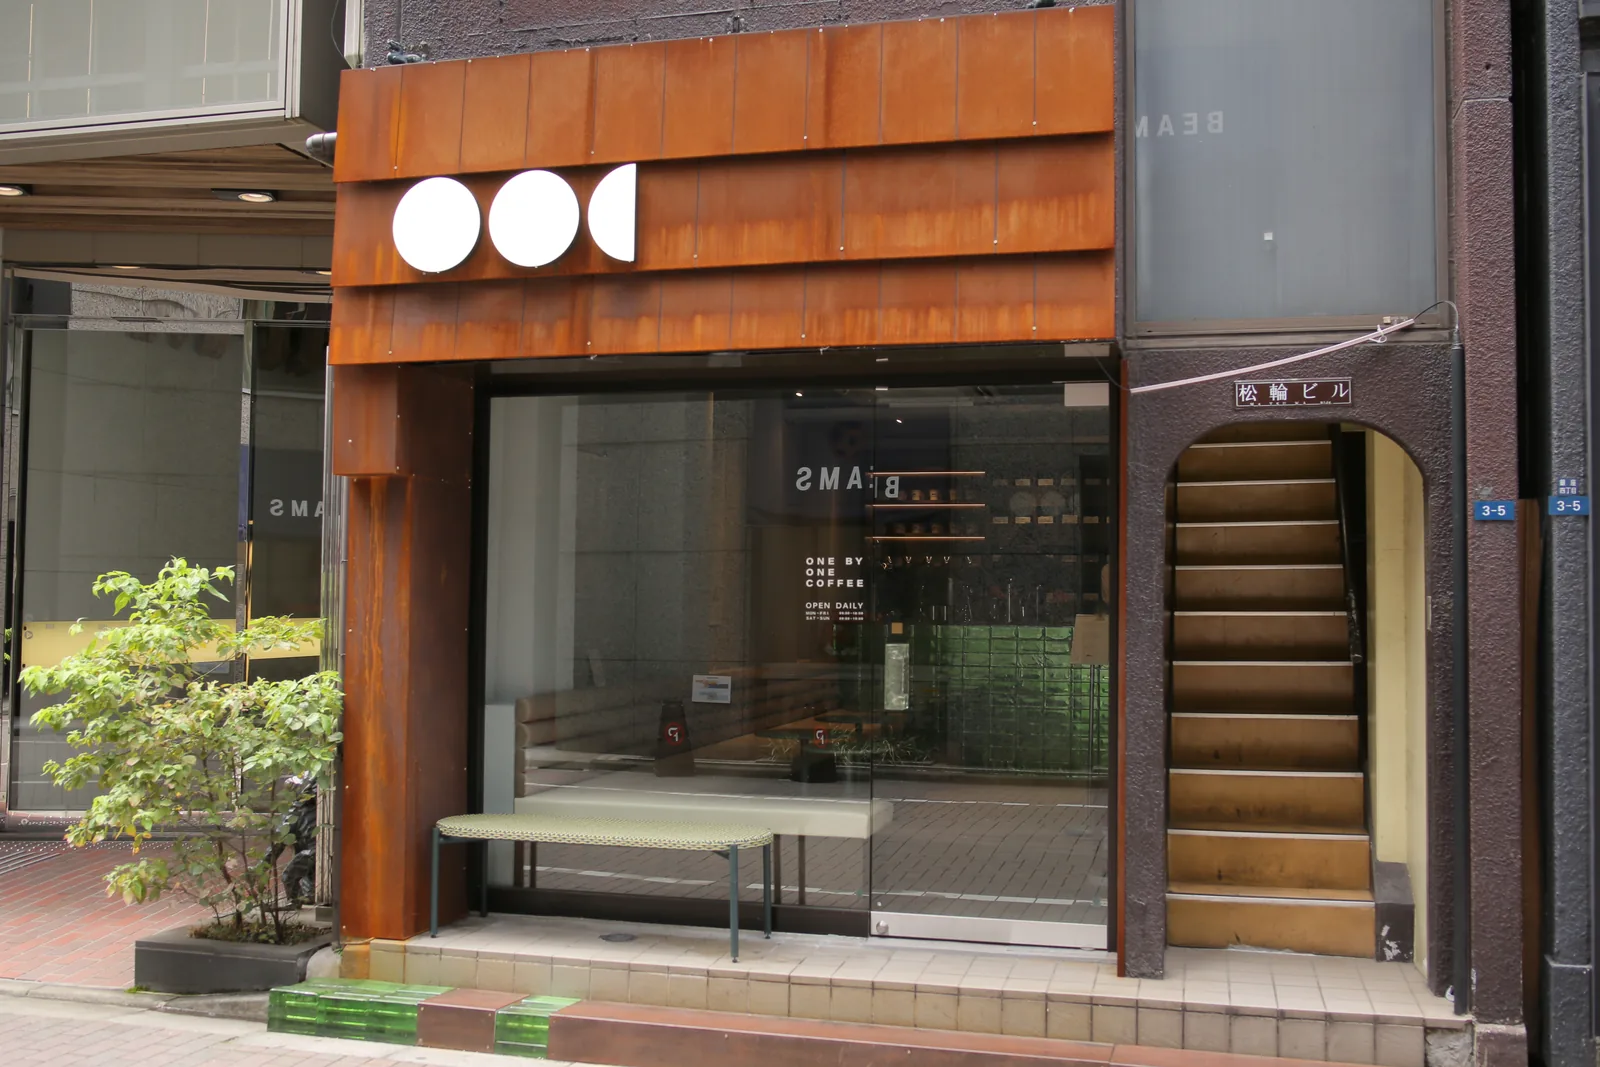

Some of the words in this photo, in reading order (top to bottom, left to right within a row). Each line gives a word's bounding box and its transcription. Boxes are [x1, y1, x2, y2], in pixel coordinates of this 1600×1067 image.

[1238, 383, 1349, 402] 松輪ビル
[1481, 505, 1506, 516] 3-5
[1556, 500, 1581, 511] 3-5
[805, 557, 835, 566] ONE
[845, 557, 864, 566] BY
[805, 568, 835, 577] ONE
[805, 579, 864, 588] COFFEE
